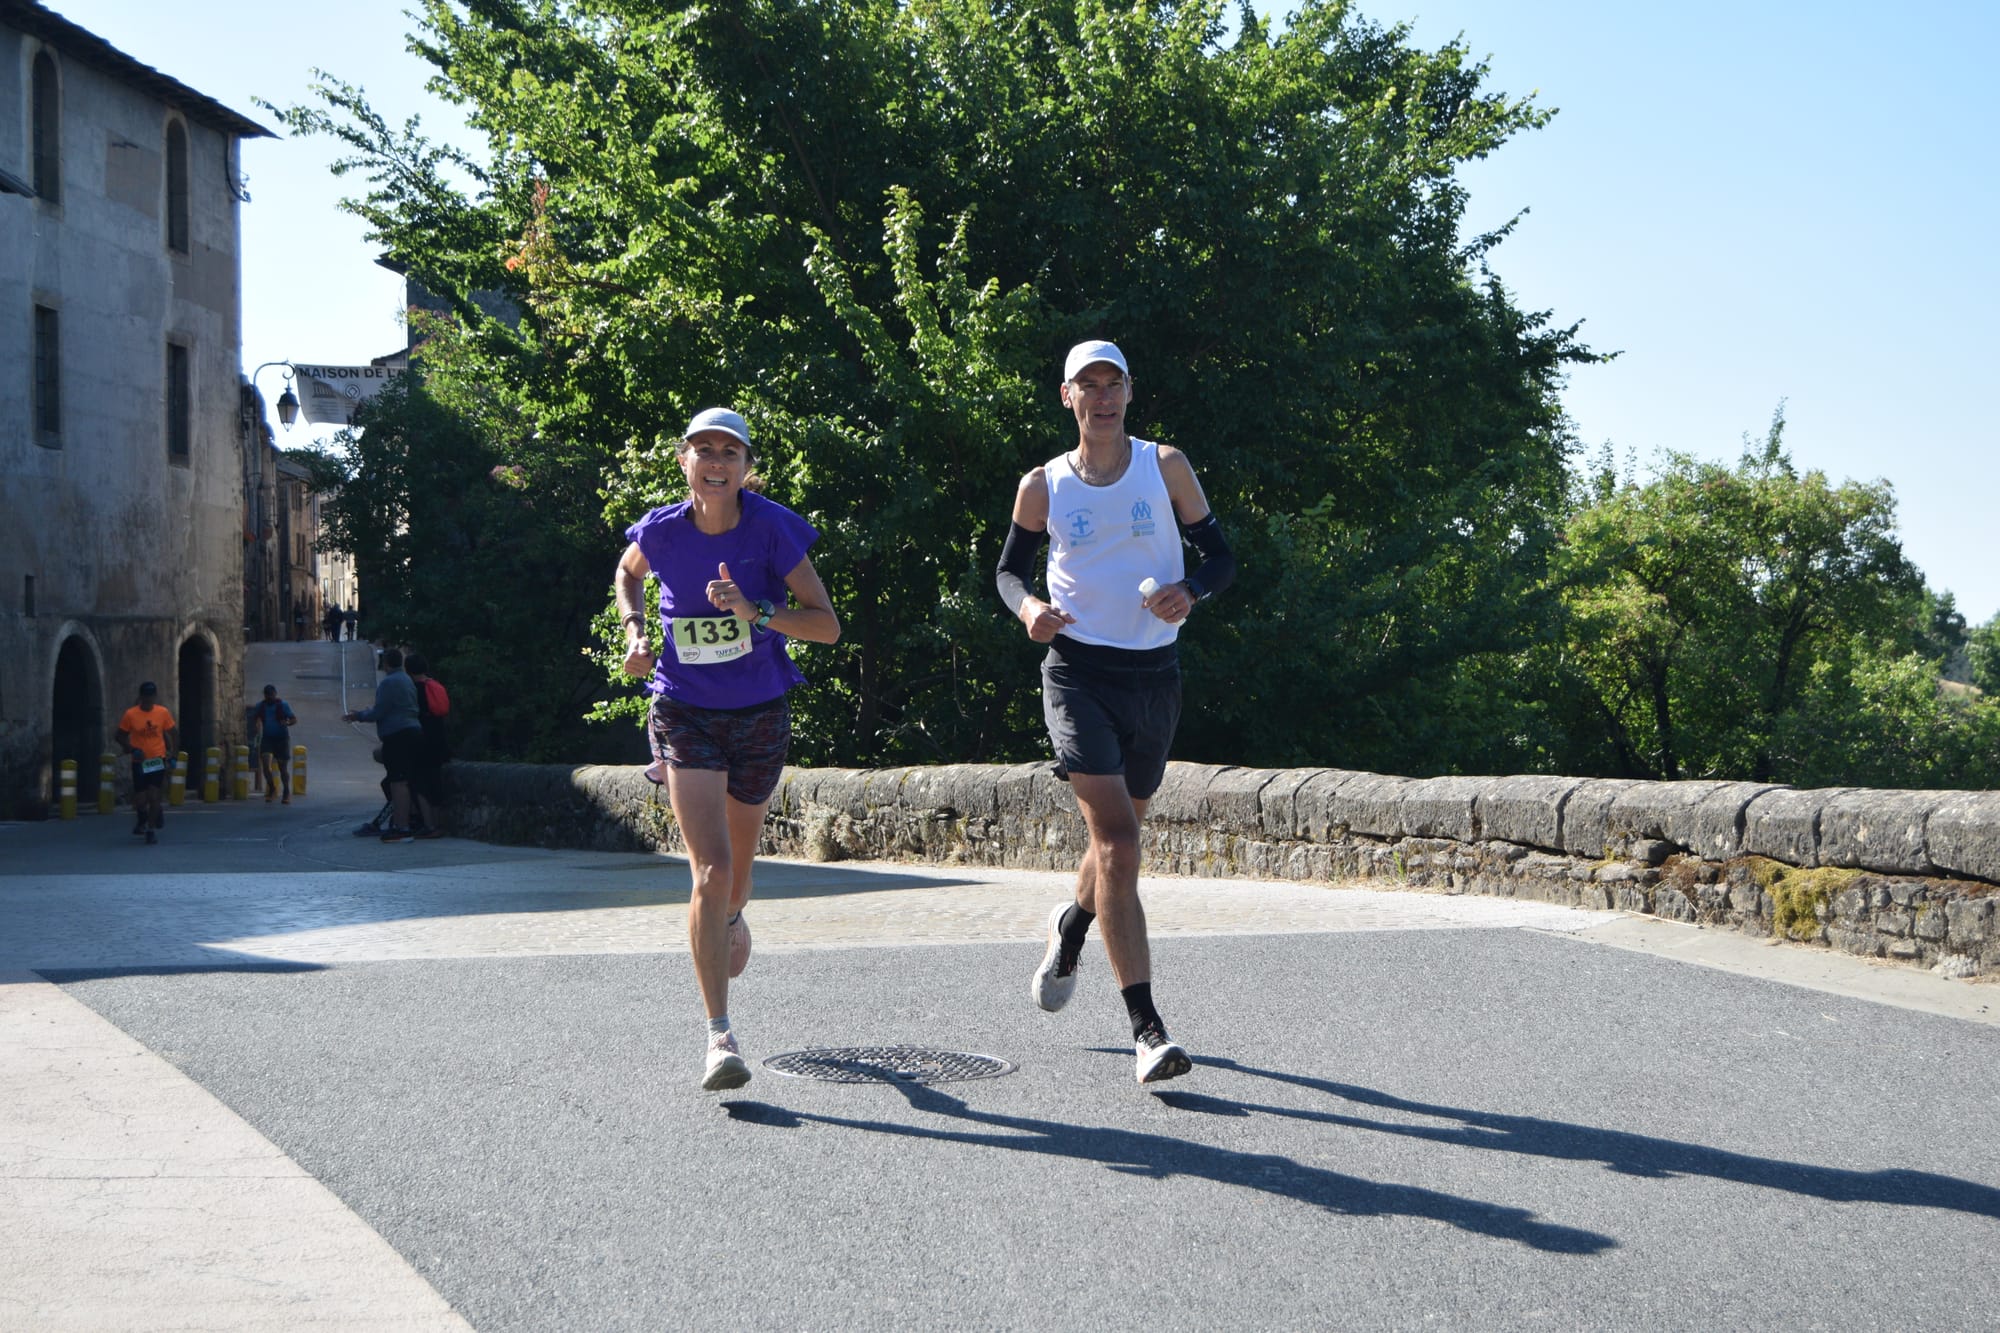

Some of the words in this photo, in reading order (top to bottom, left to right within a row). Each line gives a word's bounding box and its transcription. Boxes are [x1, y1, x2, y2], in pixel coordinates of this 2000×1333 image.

[298, 367, 360, 379] MAISON
[364, 367, 384, 379] DE
[684, 618, 740, 645] 133
